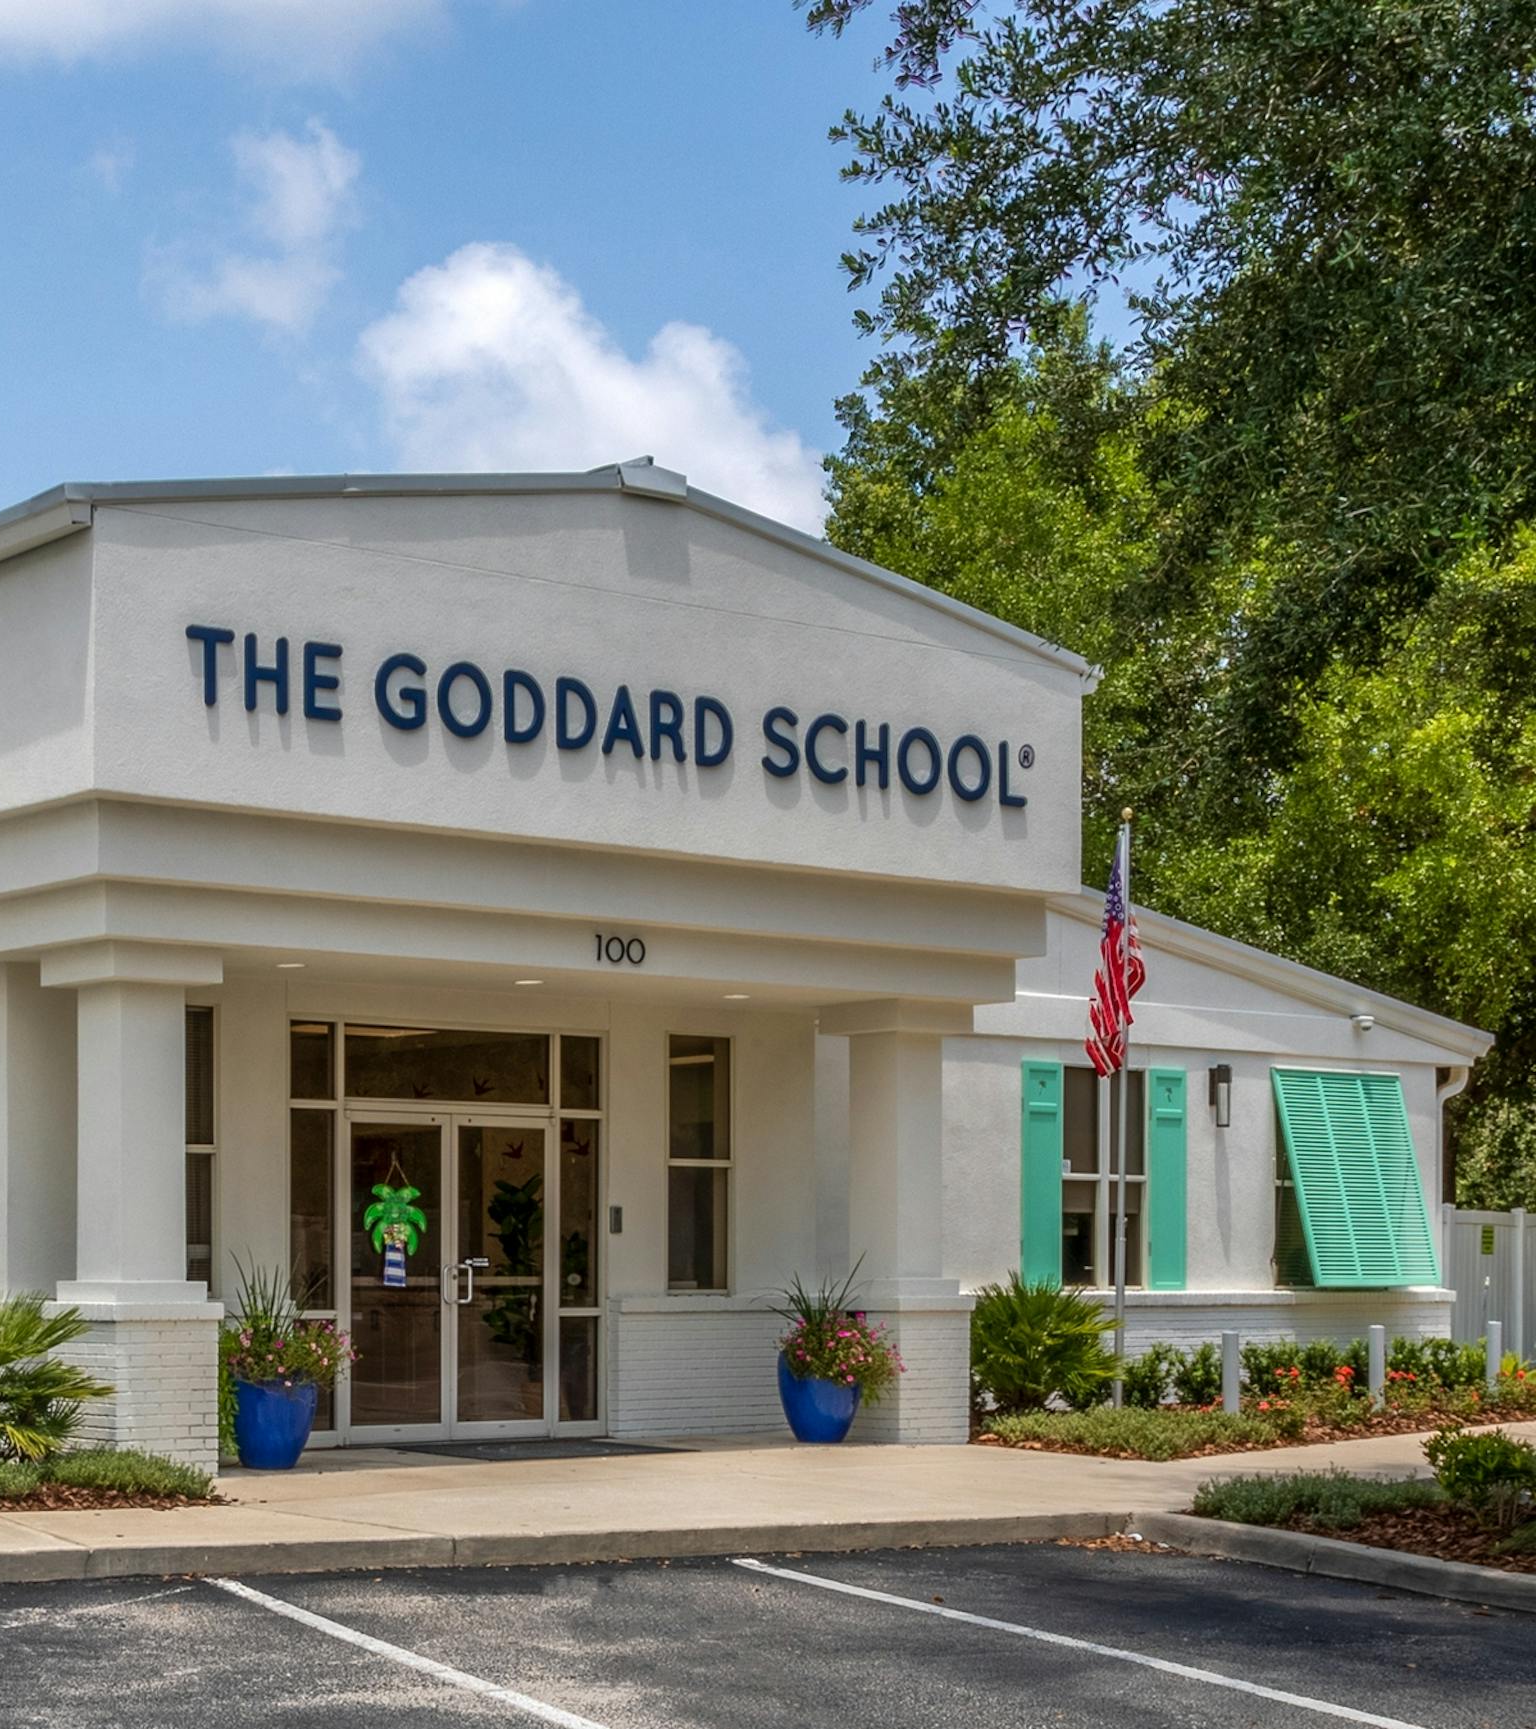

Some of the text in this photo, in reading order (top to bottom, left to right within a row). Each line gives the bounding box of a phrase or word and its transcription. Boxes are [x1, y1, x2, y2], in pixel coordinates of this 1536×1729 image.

[185, 623, 344, 722] THE
[374, 652, 734, 768] GODDARD
[595, 934, 645, 964] 100
